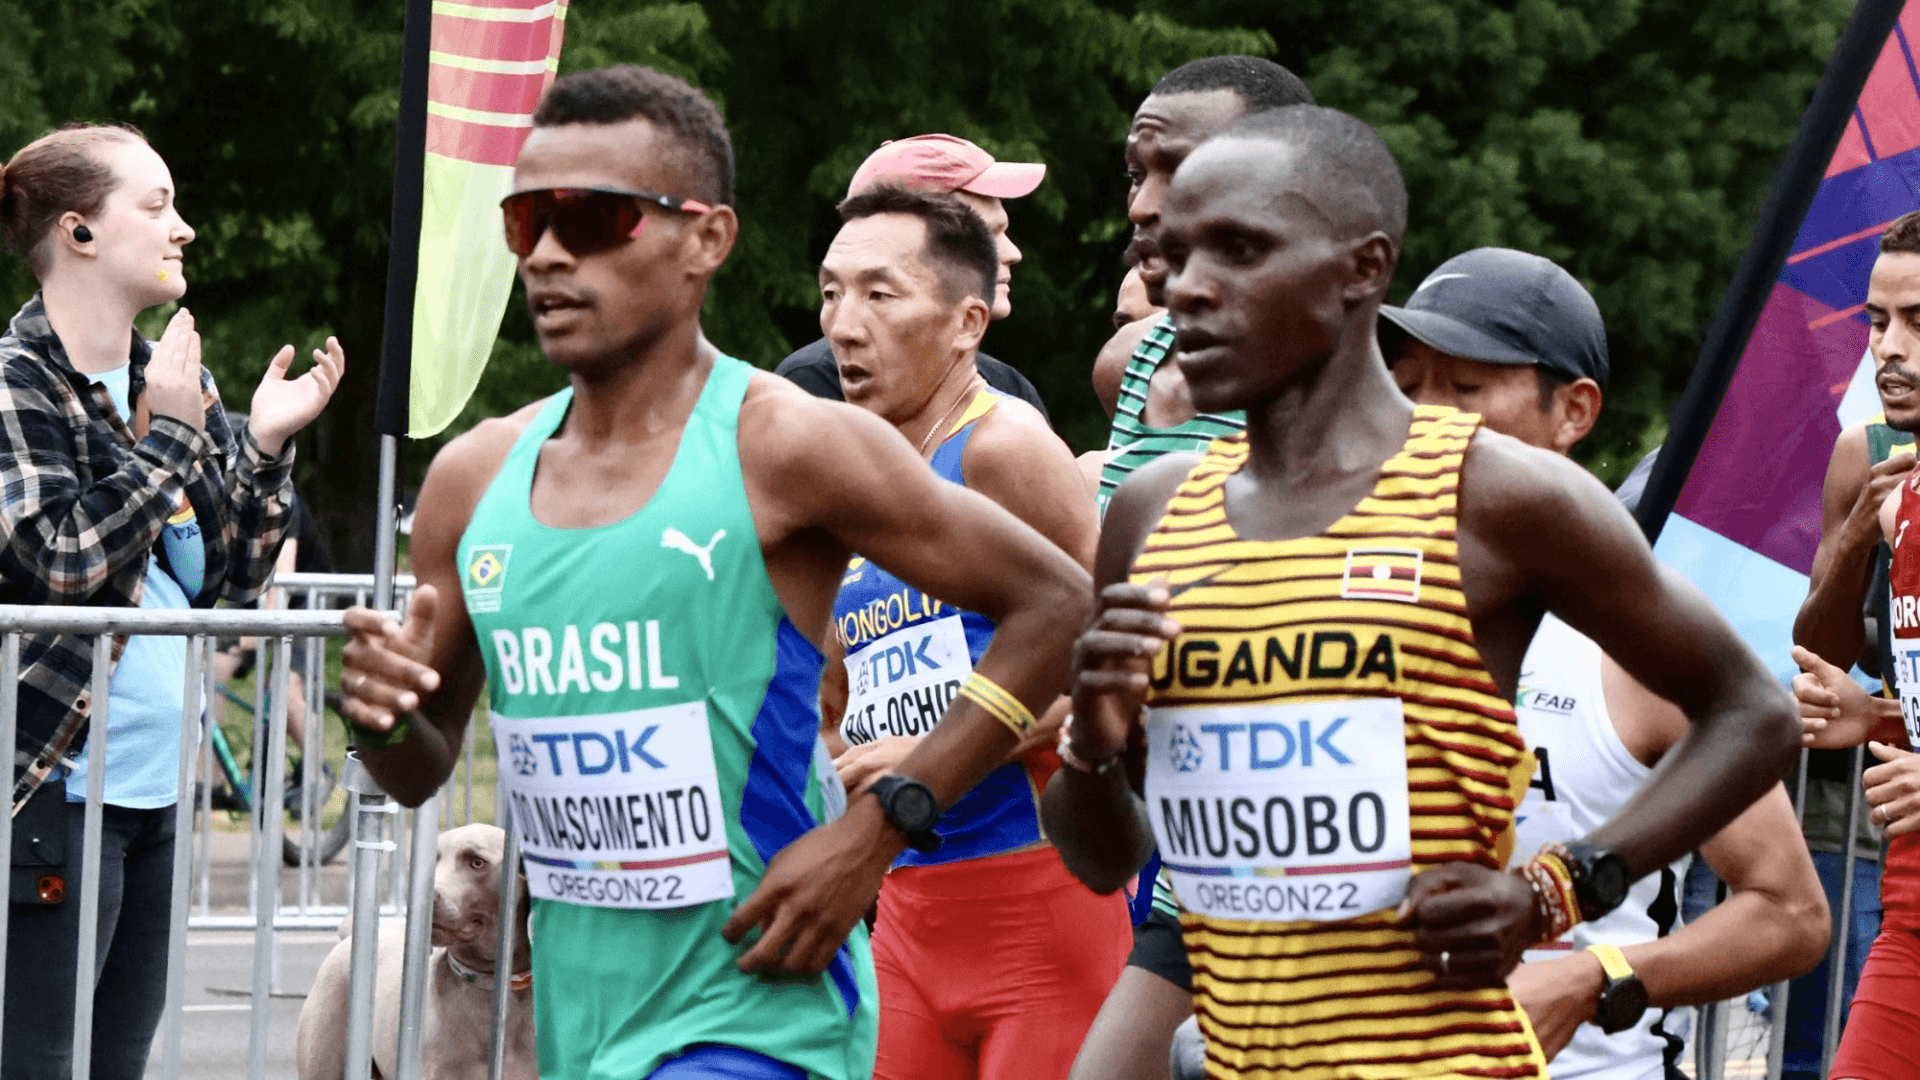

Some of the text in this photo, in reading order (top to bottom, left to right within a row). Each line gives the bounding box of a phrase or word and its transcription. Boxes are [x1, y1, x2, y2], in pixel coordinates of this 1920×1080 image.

[836, 588, 942, 649] MONGOLI
[490, 620, 680, 696] BRASIL
[869, 634, 942, 688] TDK
[1150, 631, 1397, 690] UGANDA
[1533, 692, 1576, 711] FAB
[532, 725, 668, 777] TDK
[1200, 717, 1355, 771] TDK
[533, 785, 712, 851] NASCIMENTO
[1160, 791, 1387, 858] MUSOBO
[547, 873, 686, 902] OREGON22
[1196, 882, 1361, 913] OREGON22
